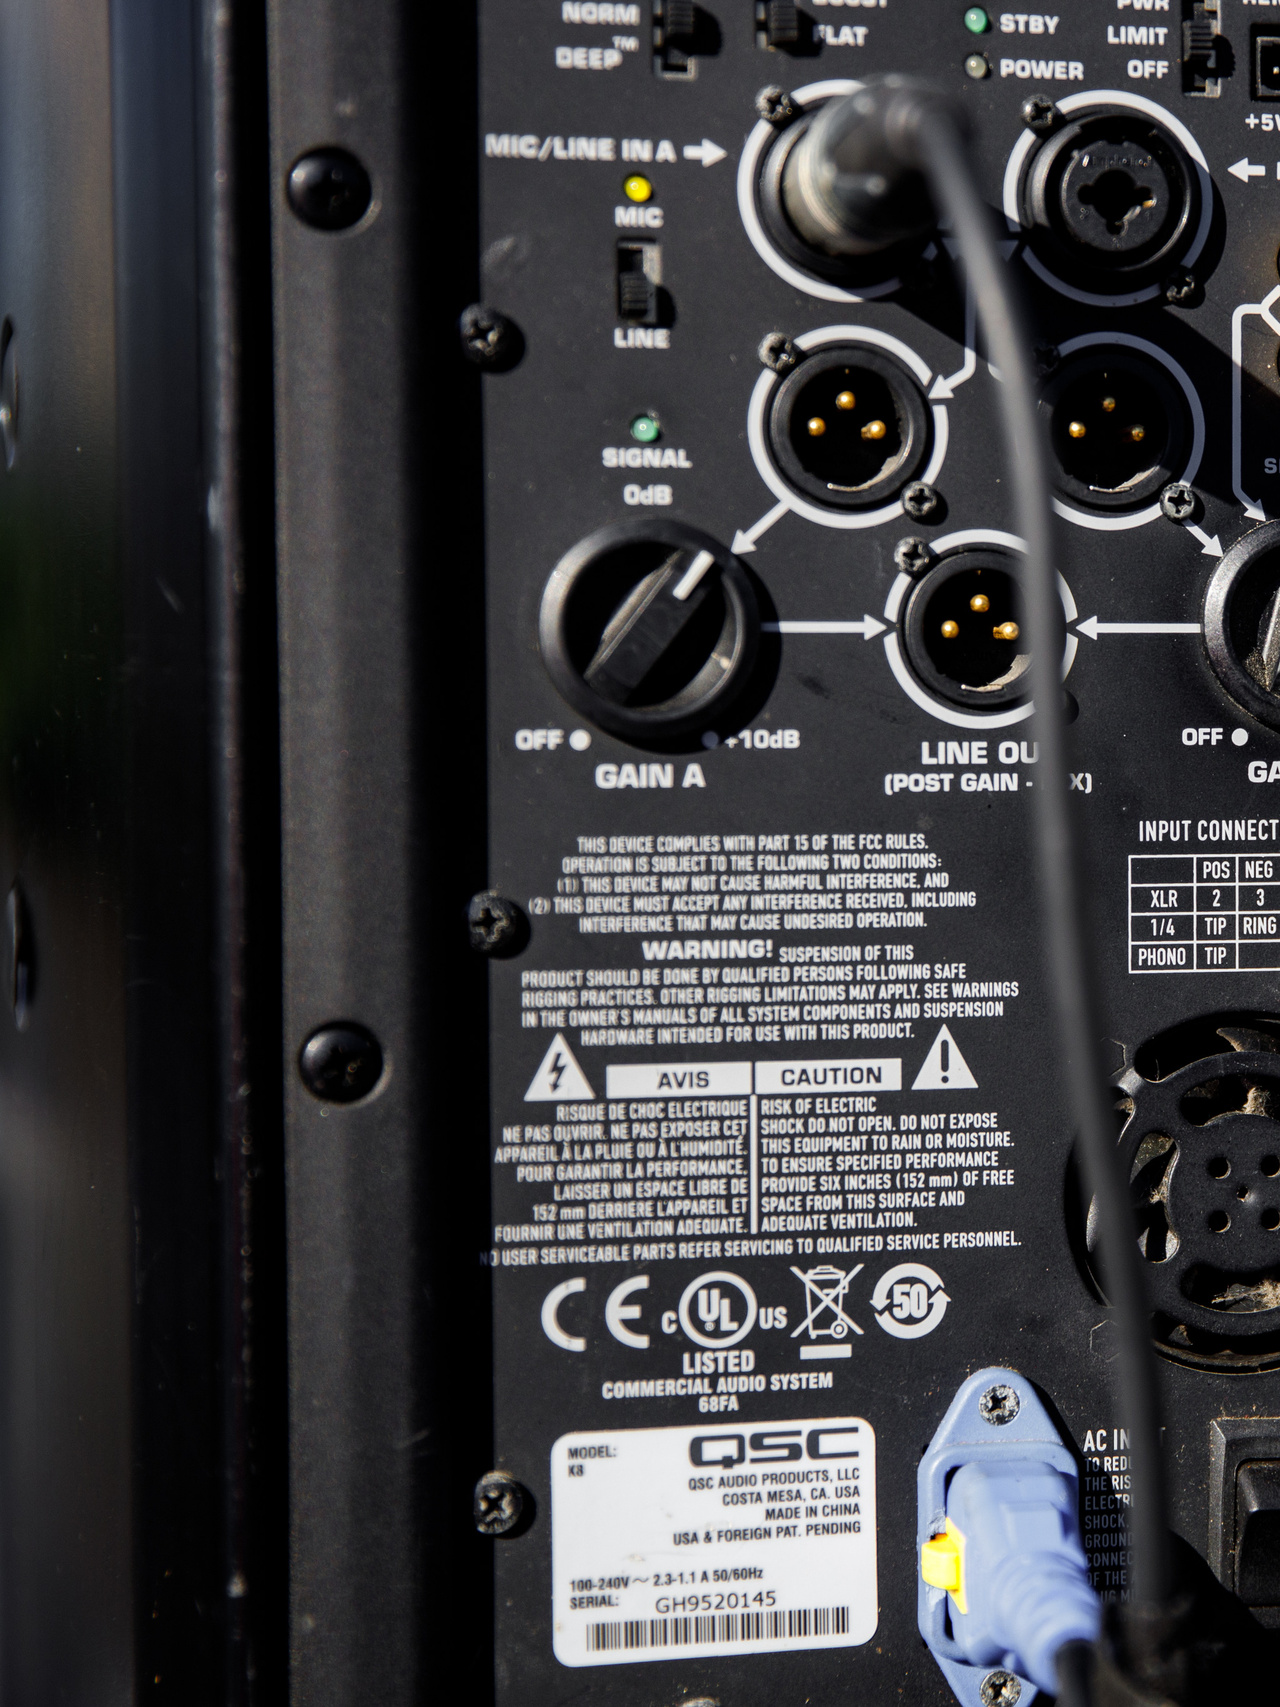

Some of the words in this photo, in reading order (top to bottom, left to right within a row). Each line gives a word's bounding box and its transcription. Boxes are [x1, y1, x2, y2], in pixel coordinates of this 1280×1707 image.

[562, 2, 640, 26] NORM
[1000, 14, 1059, 34] STBY
[813, 24, 869, 47] FLAT
[1107, 26, 1168, 46] LIMIT
[1000, 59, 1084, 81] POWER
[1127, 60, 1169, 79] OFF
[485, 134, 616, 161] MIC/LINE
[622, 140, 653, 162] IN
[655, 140, 677, 163] A
[615, 206, 664, 228] MIC
[614, 328, 670, 349] LINE
[602, 447, 693, 468] SIGNAL
[624, 484, 673, 505] 0dB
[515, 729, 564, 750] OFF
[725, 729, 800, 750] +10dB
[1181, 728, 1223, 745] OFF
[921, 741, 987, 764] LINE
[998, 741, 1042, 763] OU
[595, 763, 674, 788] GAIN
[682, 763, 706, 788] A
[884, 773, 954, 795] (POST
[960, 773, 1018, 792] GAIN
[1139, 820, 1191, 842] INPUT
[577, 836, 607, 853] THIS
[609, 836, 654, 852] DEVICE
[657, 836, 721, 852] COMPLIES
[723, 835, 755, 851] WITH
[758, 835, 790, 850] PART
[794, 835, 808, 850] 15
[812, 834, 828, 850] OF
[832, 834, 855, 850] THE
[859, 834, 882, 849] FCC
[886, 833, 928, 849] RULES.
[1203, 861, 1230, 879] POS
[1245, 861, 1273, 878] NEG
[1151, 889, 1178, 908] XLR
[1212, 889, 1221, 907] 2
[1256, 888, 1265, 906] 3
[1151, 918, 1175, 936] 1/4
[1204, 917, 1227, 936] TIP
[1243, 916, 1277, 935] RING
[642, 939, 773, 960] WARNING!
[779, 946, 861, 962] SUSPENSION
[864, 946, 881, 961] OF
[884, 945, 914, 960] THIS
[1138, 947, 1186, 966] PHONO
[1204, 946, 1227, 965] TIP
[657, 1071, 709, 1090] AVIS
[781, 1066, 882, 1086] CAUTION
[761, 1098, 791, 1116] RISK
[795, 1098, 812, 1114] OF
[815, 1097, 876, 1113] ELECTRIC
[761, 1118, 804, 1135] SHOCK
[808, 1118, 825, 1133] DO
[829, 1117, 854, 1132] NOT
[858, 1116, 896, 1132] OPEN.
[900, 1115, 917, 1131] DO
[921, 1114, 946, 1130] NOT
[950, 1113, 997, 1129] EXPOSE
[761, 1138, 791, 1154] THIS
[795, 1136, 868, 1153] EQUIPMENT
[872, 1135, 888, 1150] TO
[892, 1134, 922, 1150] RAIN
[925, 1133, 943, 1149] OR
[947, 1131, 1014, 1148] MOISTURE.
[761, 1158, 778, 1174] TO
[782, 1156, 832, 1173] ENSURE
[836, 1154, 902, 1171] SPECIFIED
[905, 1151, 999, 1170] PERFORMANCE
[761, 1176, 817, 1193] PROVIDE
[820, 1175, 841, 1191] SIX
[844, 1174, 891, 1190] INCHES
[896, 1172, 925, 1189] (152
[929, 1171, 958, 1188] mm)
[963, 1170, 979, 1186] OF
[982, 1170, 1014, 1185] FREE
[761, 1196, 802, 1212] SPACE
[806, 1194, 842, 1211] FROM
[846, 1193, 875, 1209] THIS
[879, 1191, 935, 1208] SURFACE
[939, 1191, 965, 1206] AND
[761, 1215, 827, 1232] ADEQUATE
[831, 1212, 917, 1229] VENTILATION.
[893, 1284, 928, 1319] 50
[759, 1307, 788, 1330] US
[682, 1350, 756, 1376] LISTED
[602, 1378, 712, 1400] COMMERCIAL
[716, 1375, 766, 1395] AUDIO
[770, 1372, 833, 1391] SYSTEM
[698, 1395, 739, 1413] 68FA
[689, 1426, 860, 1470] QSC
[1083, 1429, 1107, 1452] AC
[568, 1445, 617, 1460] MODEL:
[568, 1464, 584, 1478] K8
[1084, 1457, 1100, 1472] TO
[688, 1477, 714, 1491] QSC
[718, 1473, 757, 1489] AUDIO
[761, 1469, 833, 1486] PRODUCTS,
[837, 1467, 860, 1481] LLC
[1084, 1476, 1107, 1491] THE
[1112, 1475, 1132, 1490] RIS
[722, 1491, 763, 1506] COSTA
[767, 1489, 806, 1504] MESA,
[810, 1487, 830, 1501] CA.
[834, 1485, 860, 1499] USA
[765, 1507, 801, 1521] MADE
[806, 1506, 818, 1518] IN
[822, 1503, 860, 1517] CHINA
[673, 1532, 699, 1546] USA
[704, 1531, 713, 1543] &
[717, 1526, 772, 1543] FOREIGN
[776, 1525, 802, 1538] PAT.
[806, 1521, 861, 1537] PENDING
[570, 1575, 630, 1593] 100-240V
[653, 1571, 697, 1586] 2.3-1.1
[701, 1570, 709, 1583] A
[713, 1567, 764, 1582] 50/60Hz
[569, 1595, 620, 1610] SERIAL:
[655, 1590, 776, 1614] GH9520145
